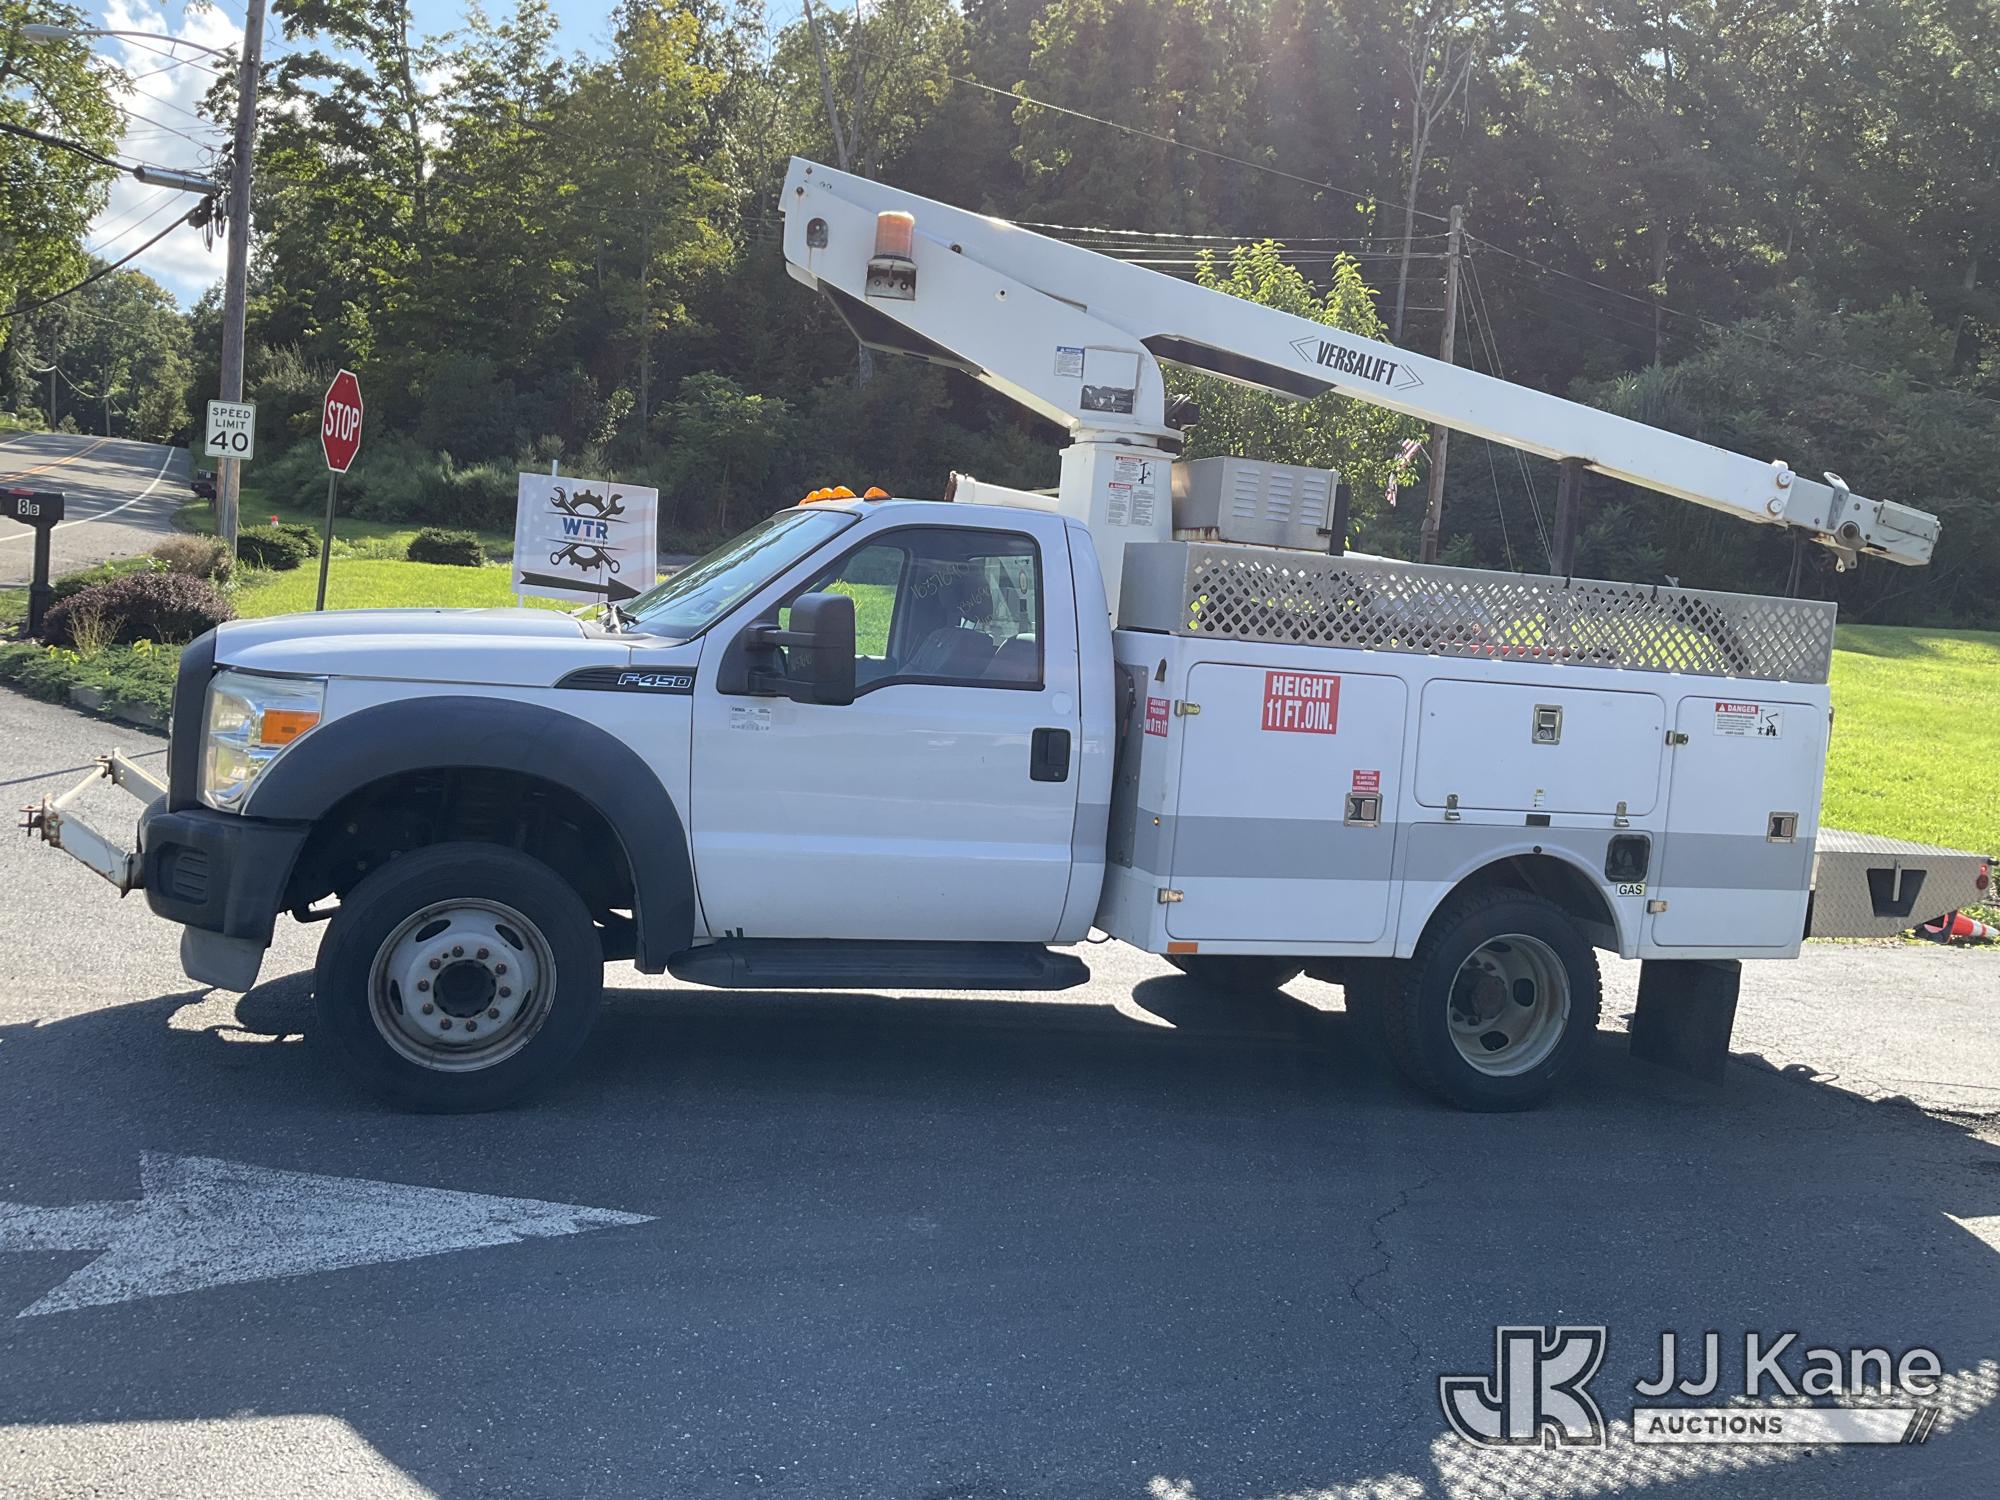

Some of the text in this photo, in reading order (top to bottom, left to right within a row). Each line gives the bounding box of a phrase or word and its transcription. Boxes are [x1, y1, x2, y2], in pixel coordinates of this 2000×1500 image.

[1316, 340, 1398, 385] VERSALIFT
[212, 407, 251, 419] SPEED
[325, 400, 360, 442] STOP
[215, 419, 246, 430] LIMIT
[210, 431, 249, 452] 40
[562, 517, 608, 540] WTR
[1272, 675, 1334, 698] HEIGHT
[1727, 704, 1756, 713] DANGER
[1619, 884, 1643, 895] GAS
